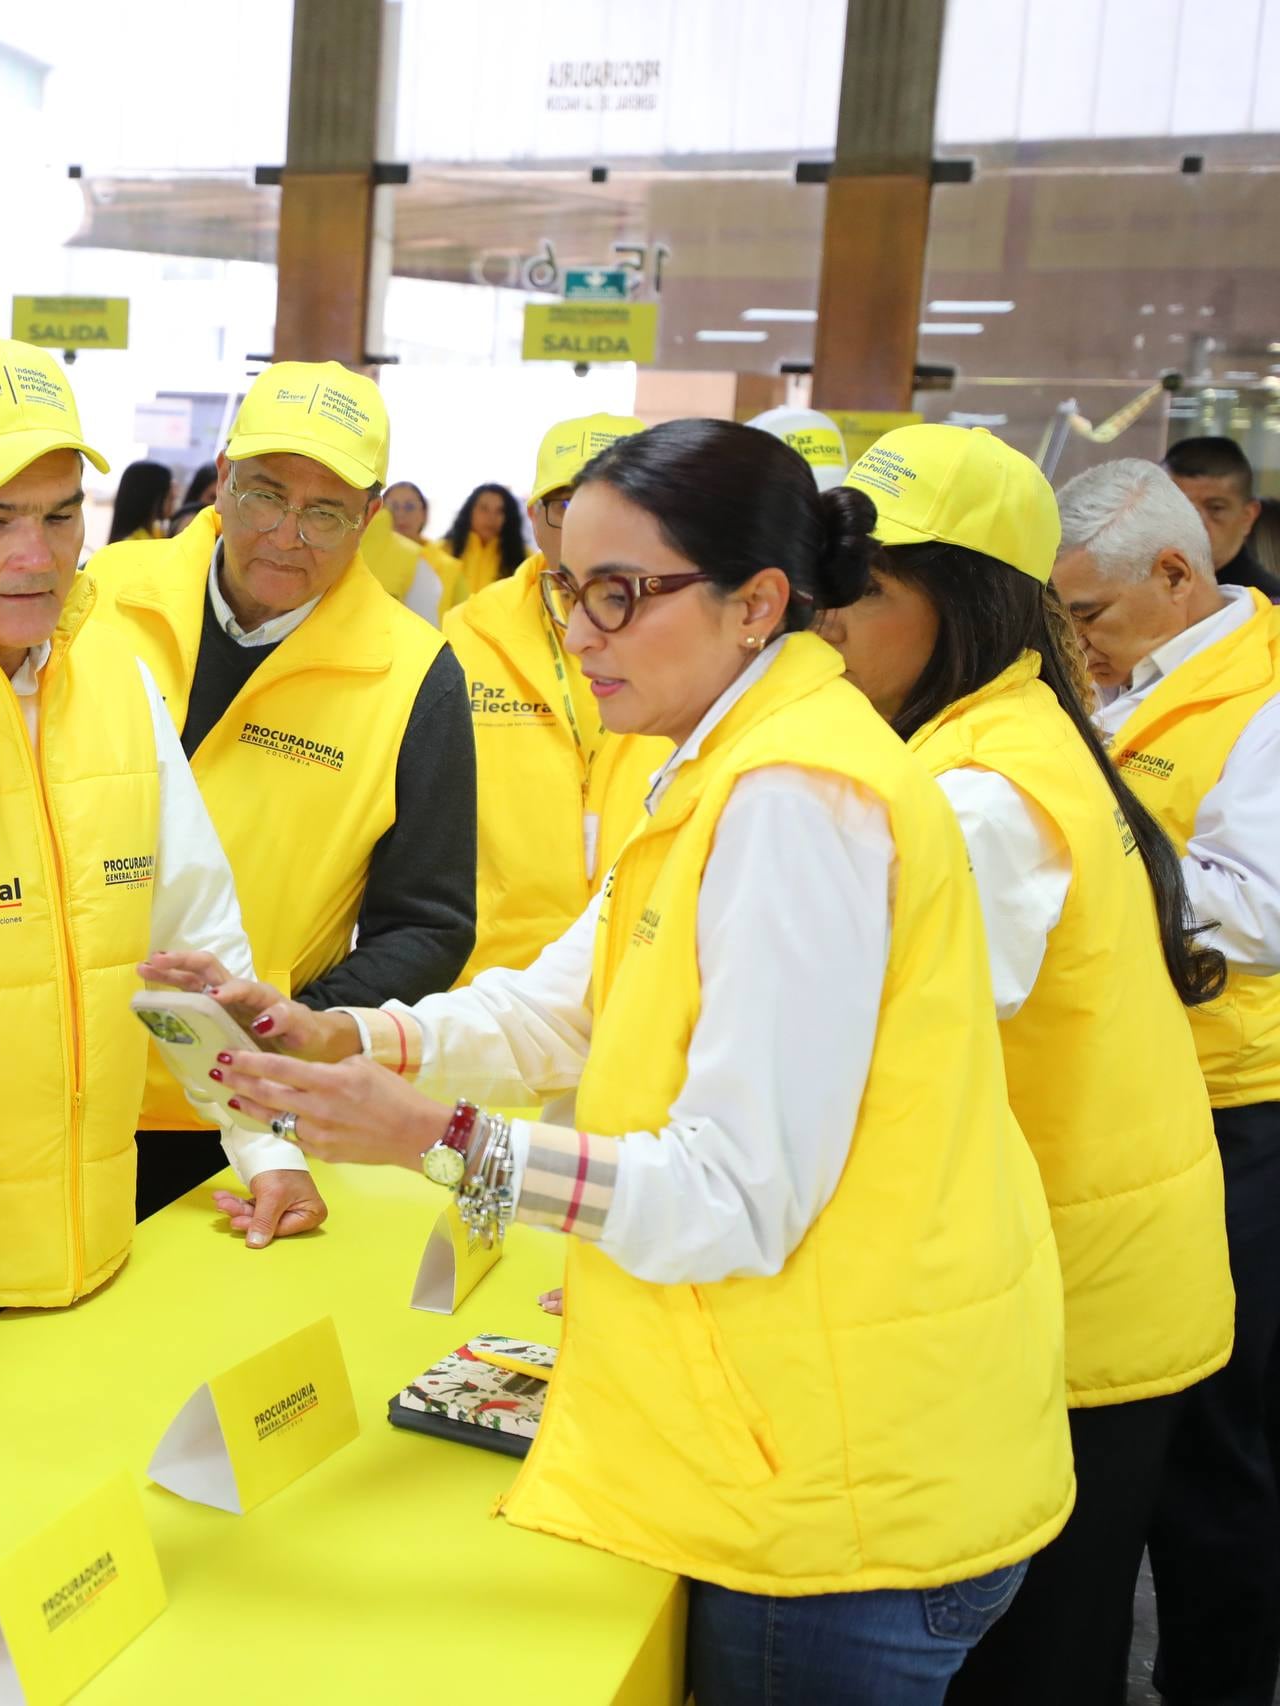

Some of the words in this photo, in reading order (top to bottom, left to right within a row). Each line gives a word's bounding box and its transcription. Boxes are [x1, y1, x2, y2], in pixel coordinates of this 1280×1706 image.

[28, 323, 110, 341] SALIDA
[542, 333, 631, 354] SALIDA
[471, 681, 506, 699] Paz
[470, 699, 553, 713] Electora
[240, 733, 279, 748] GENERAL
[282, 743, 294, 752] DE
[295, 748, 307, 757] LA
[308, 751, 343, 769] NACIÓN
[242, 722, 345, 762] PROCURADURÍA
